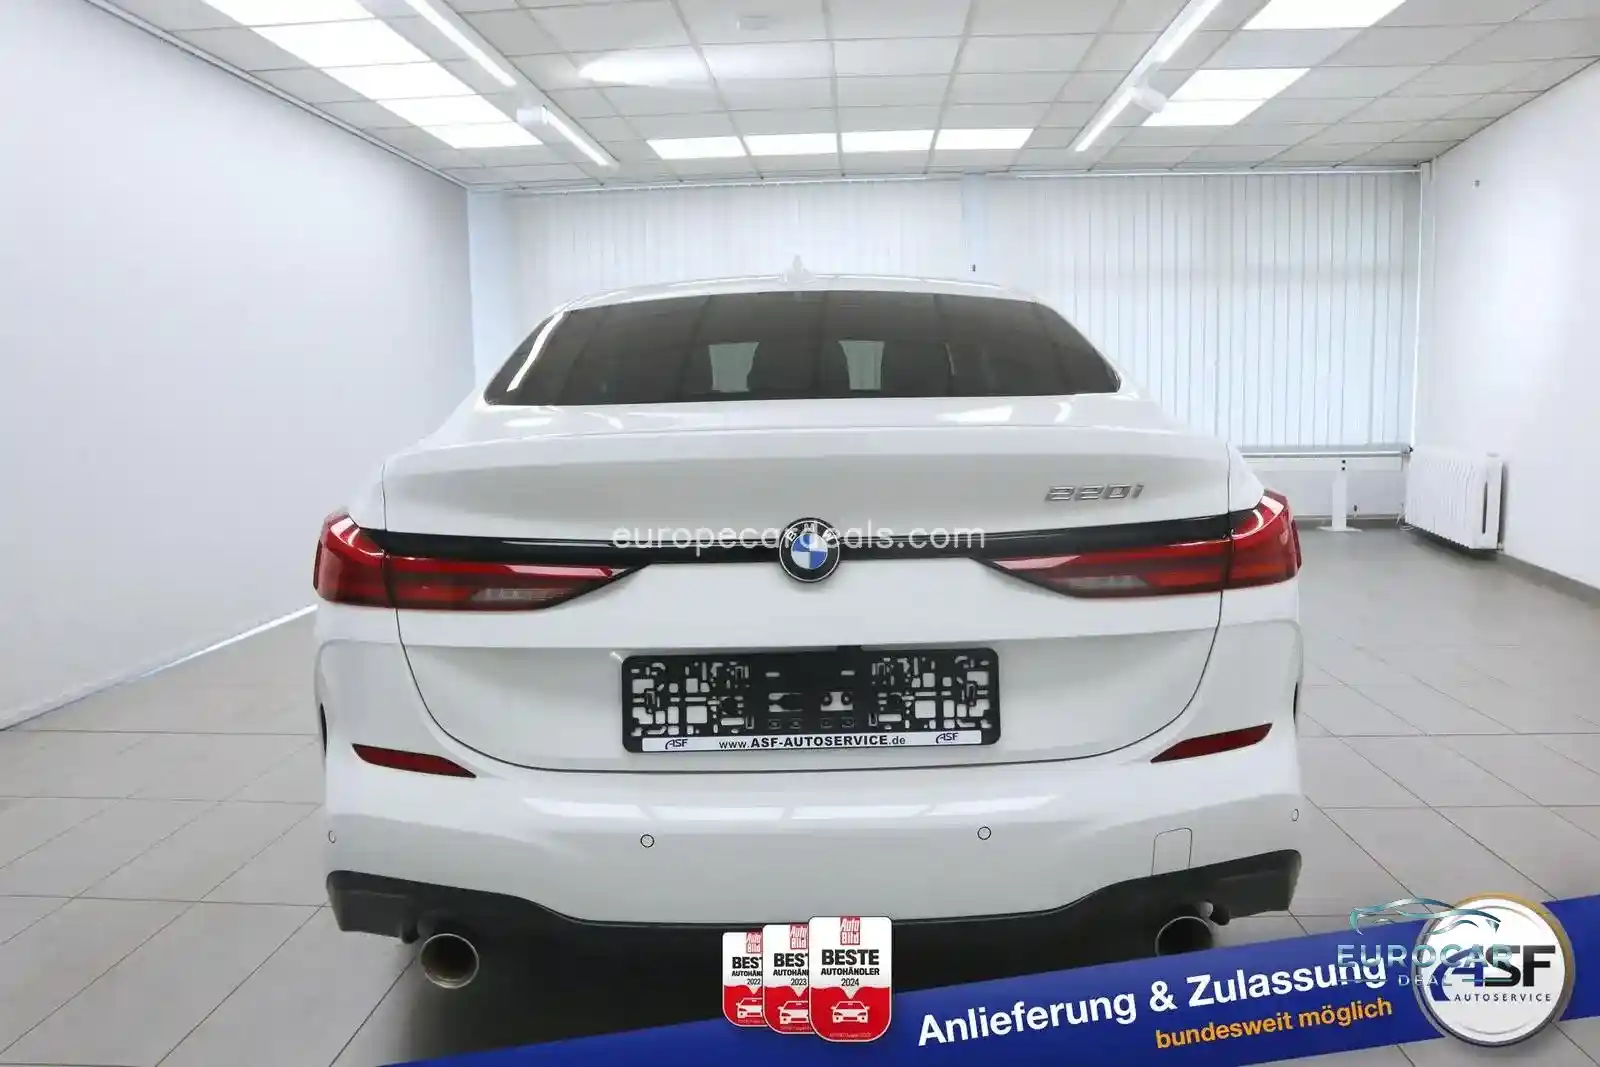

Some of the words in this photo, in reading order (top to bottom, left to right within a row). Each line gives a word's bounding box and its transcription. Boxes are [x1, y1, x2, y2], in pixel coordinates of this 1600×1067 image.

[1044, 482, 1144, 502] 220i
[786, 522, 838, 542] BMW
[664, 738, 688, 750] ASF
[719, 734, 906, 750] www.ASF-AUTOSERVICE.de
[935, 731, 959, 744] ASF
